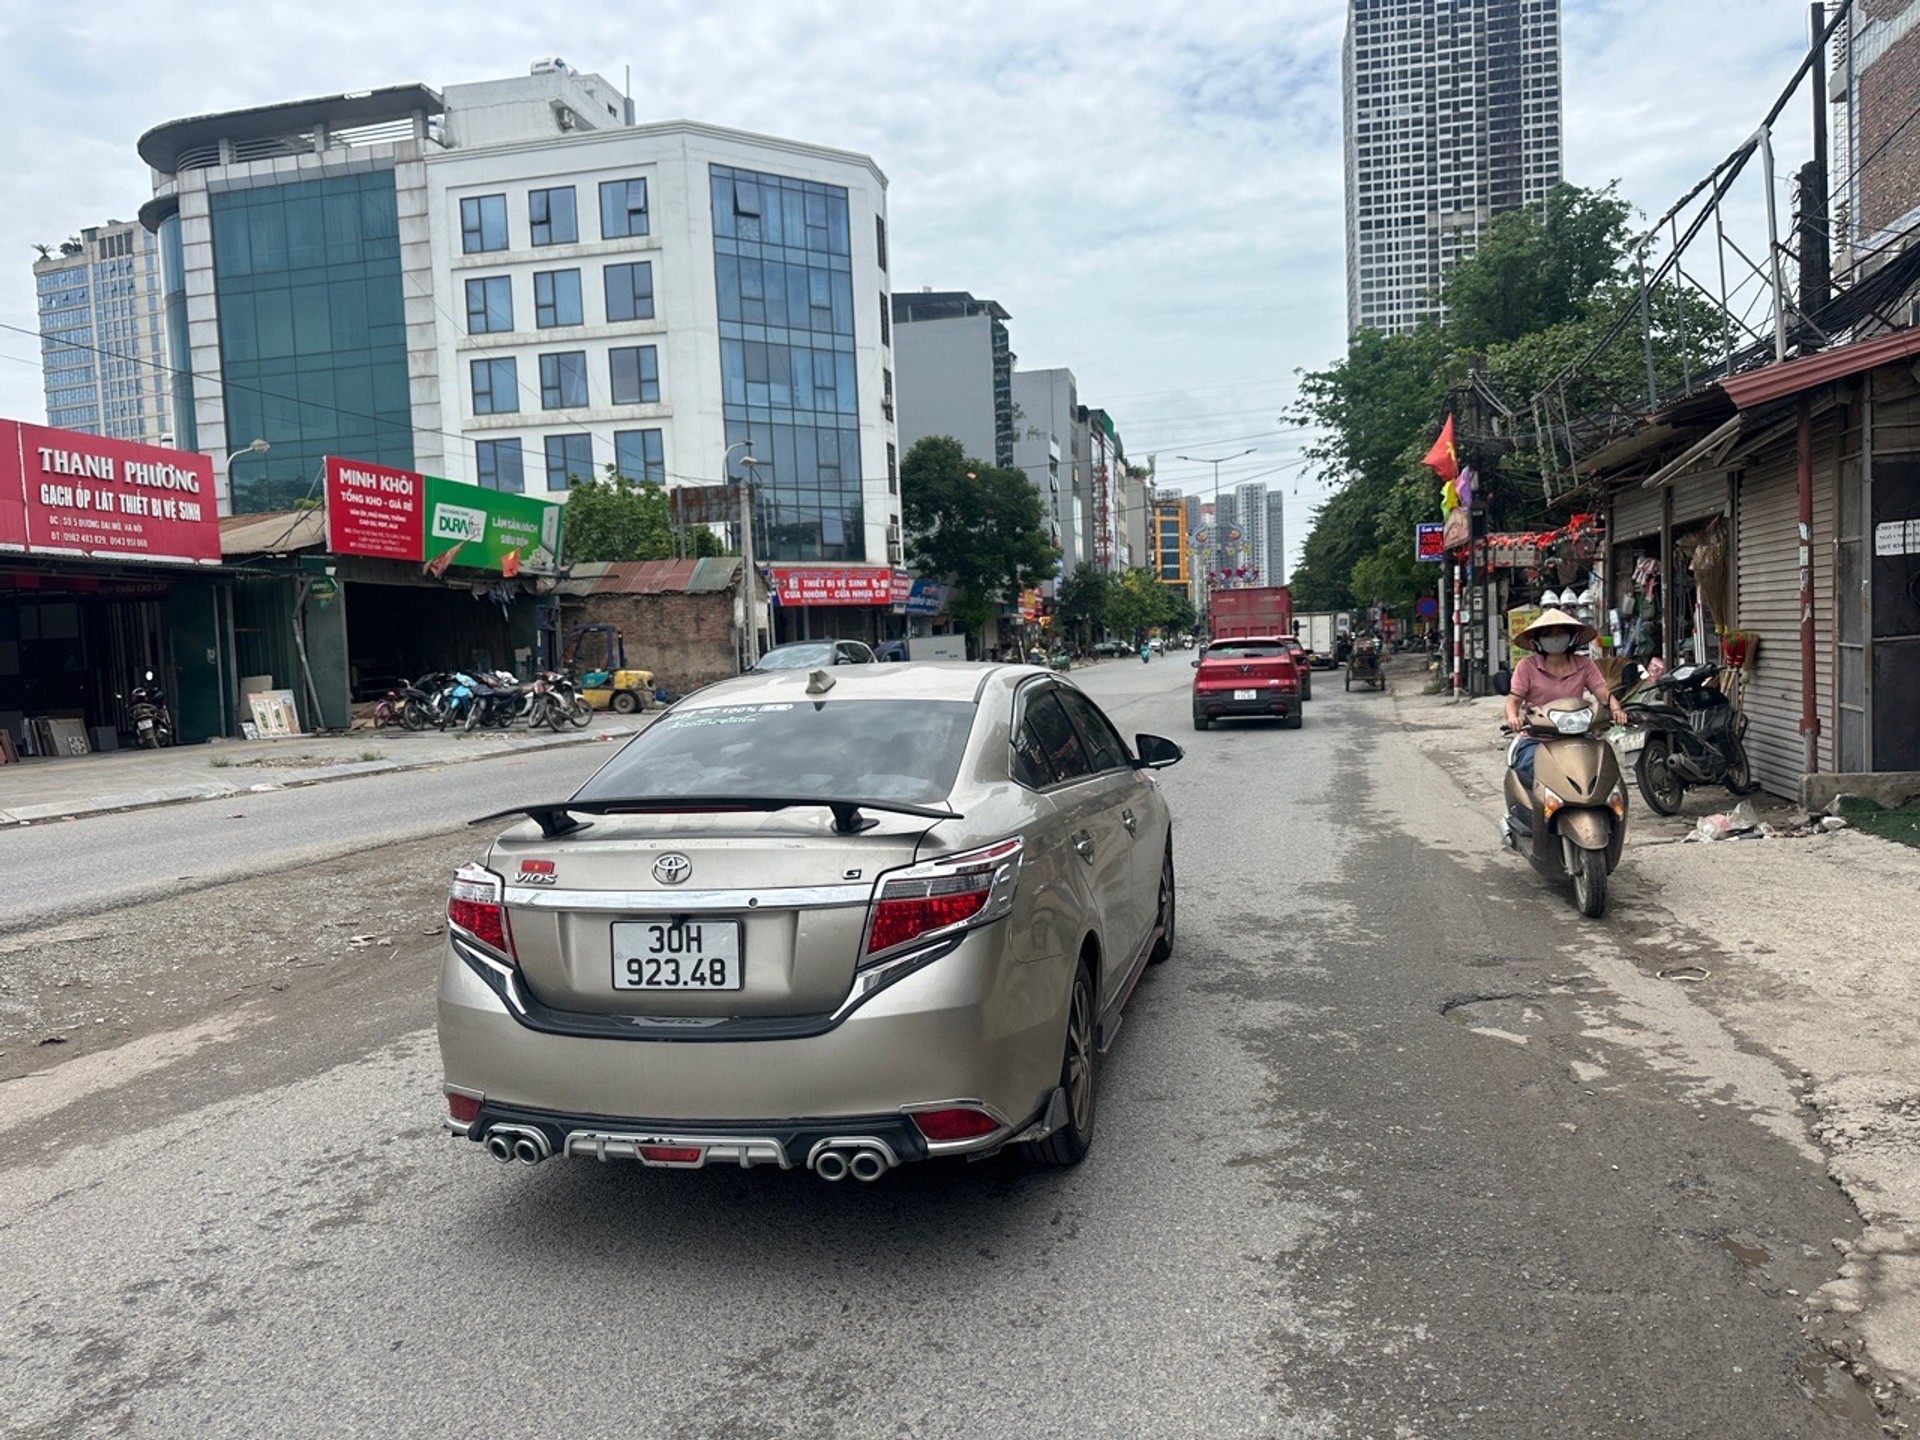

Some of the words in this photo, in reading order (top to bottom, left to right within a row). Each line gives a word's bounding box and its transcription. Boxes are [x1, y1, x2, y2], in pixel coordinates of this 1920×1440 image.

[38, 447, 114, 480] THANH
[124, 461, 200, 493] PHƯƠNG
[339, 467, 377, 489] MINH
[380, 475, 413, 496] KHÔI
[41, 483, 73, 508] GẠCH
[76, 481, 91, 508] ỐP
[95, 488, 114, 512] LÁT
[119, 489, 148, 515] THIẾT
[151, 498, 162, 520] BỊ
[163, 497, 177, 521] VỆ
[179, 501, 201, 521] SINH
[341, 488, 364, 503] TỔNG
[365, 495, 382, 507] KHO
[803, 578, 824, 587] THIẾT
[826, 578, 835, 589] BỊ
[837, 578, 846, 588] VỆ
[848, 579, 867, 588] SINH
[803, 588, 827, 598] NHÔM
[722, 706, 757, 714] 100%
[514, 872, 558, 885] VIOS
[842, 868, 862, 880] G
[648, 925, 702, 953] 30H
[627, 958, 726, 986] 923.48
